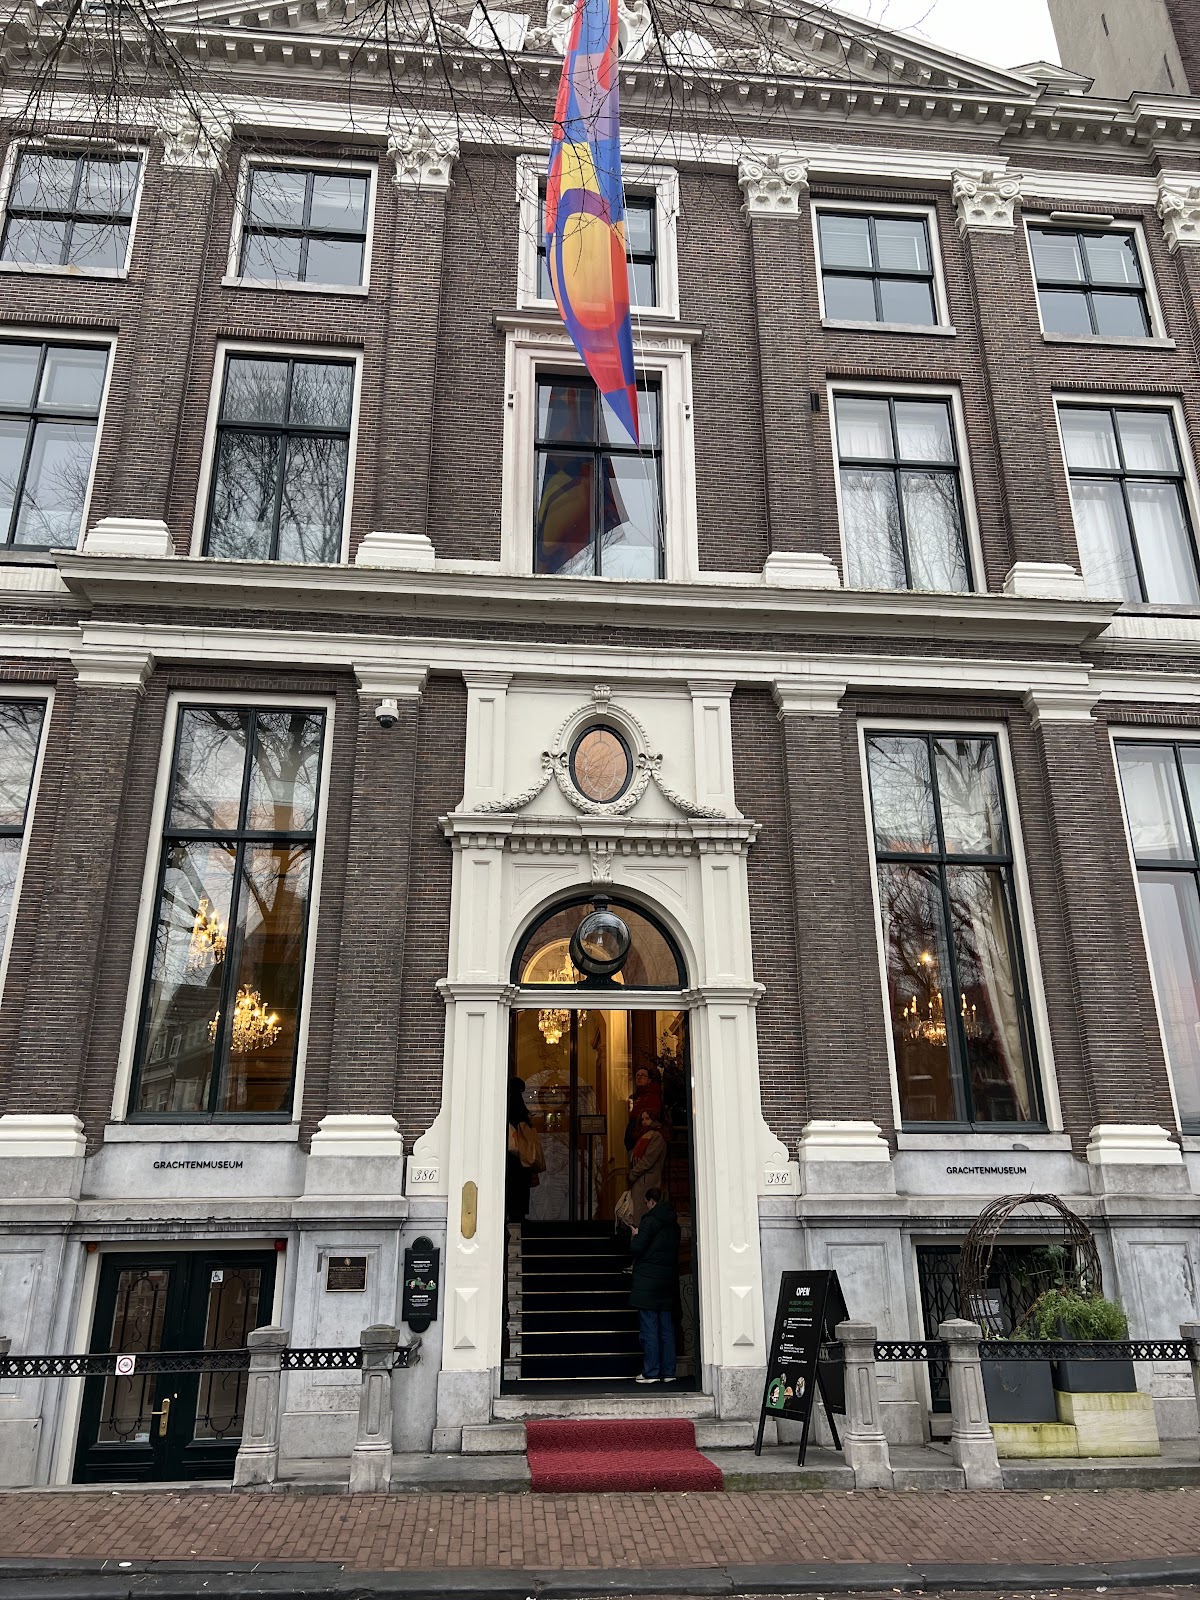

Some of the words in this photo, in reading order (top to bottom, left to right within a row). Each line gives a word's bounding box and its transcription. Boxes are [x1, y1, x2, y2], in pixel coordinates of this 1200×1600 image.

[153, 1160, 244, 1169] GRACHTENMUSEUM
[414, 1169, 437, 1181] 386
[946, 1166, 1027, 1175] GRACHTENMUSEUM
[767, 1172, 789, 1184] 386
[796, 1287, 810, 1296] OPEN
